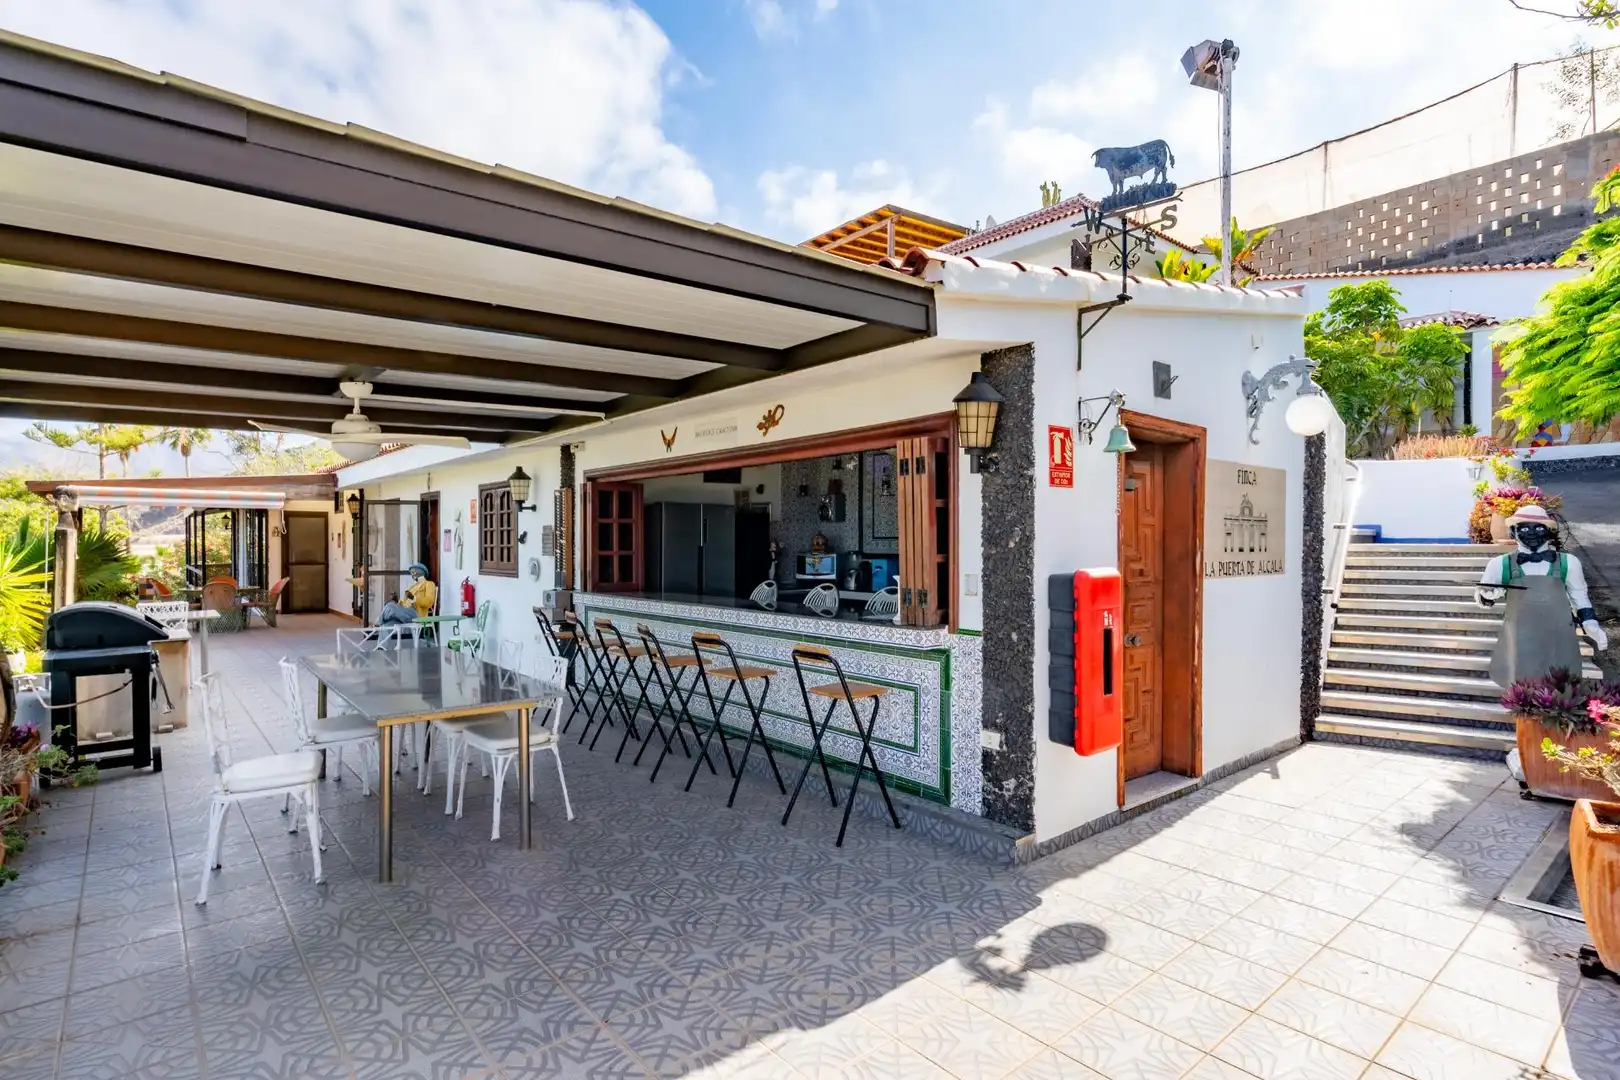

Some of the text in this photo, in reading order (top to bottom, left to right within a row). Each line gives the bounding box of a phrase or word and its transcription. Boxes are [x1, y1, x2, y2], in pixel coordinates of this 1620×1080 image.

[1084, 206, 1103, 234] W
[1160, 204, 1178, 231] S
[1144, 231, 1156, 254] E
[1237, 469, 1257, 486] FINCA
[1204, 561, 1215, 578] LA
[1218, 560, 1245, 577] PUERTA
[1247, 560, 1255, 575] DE
